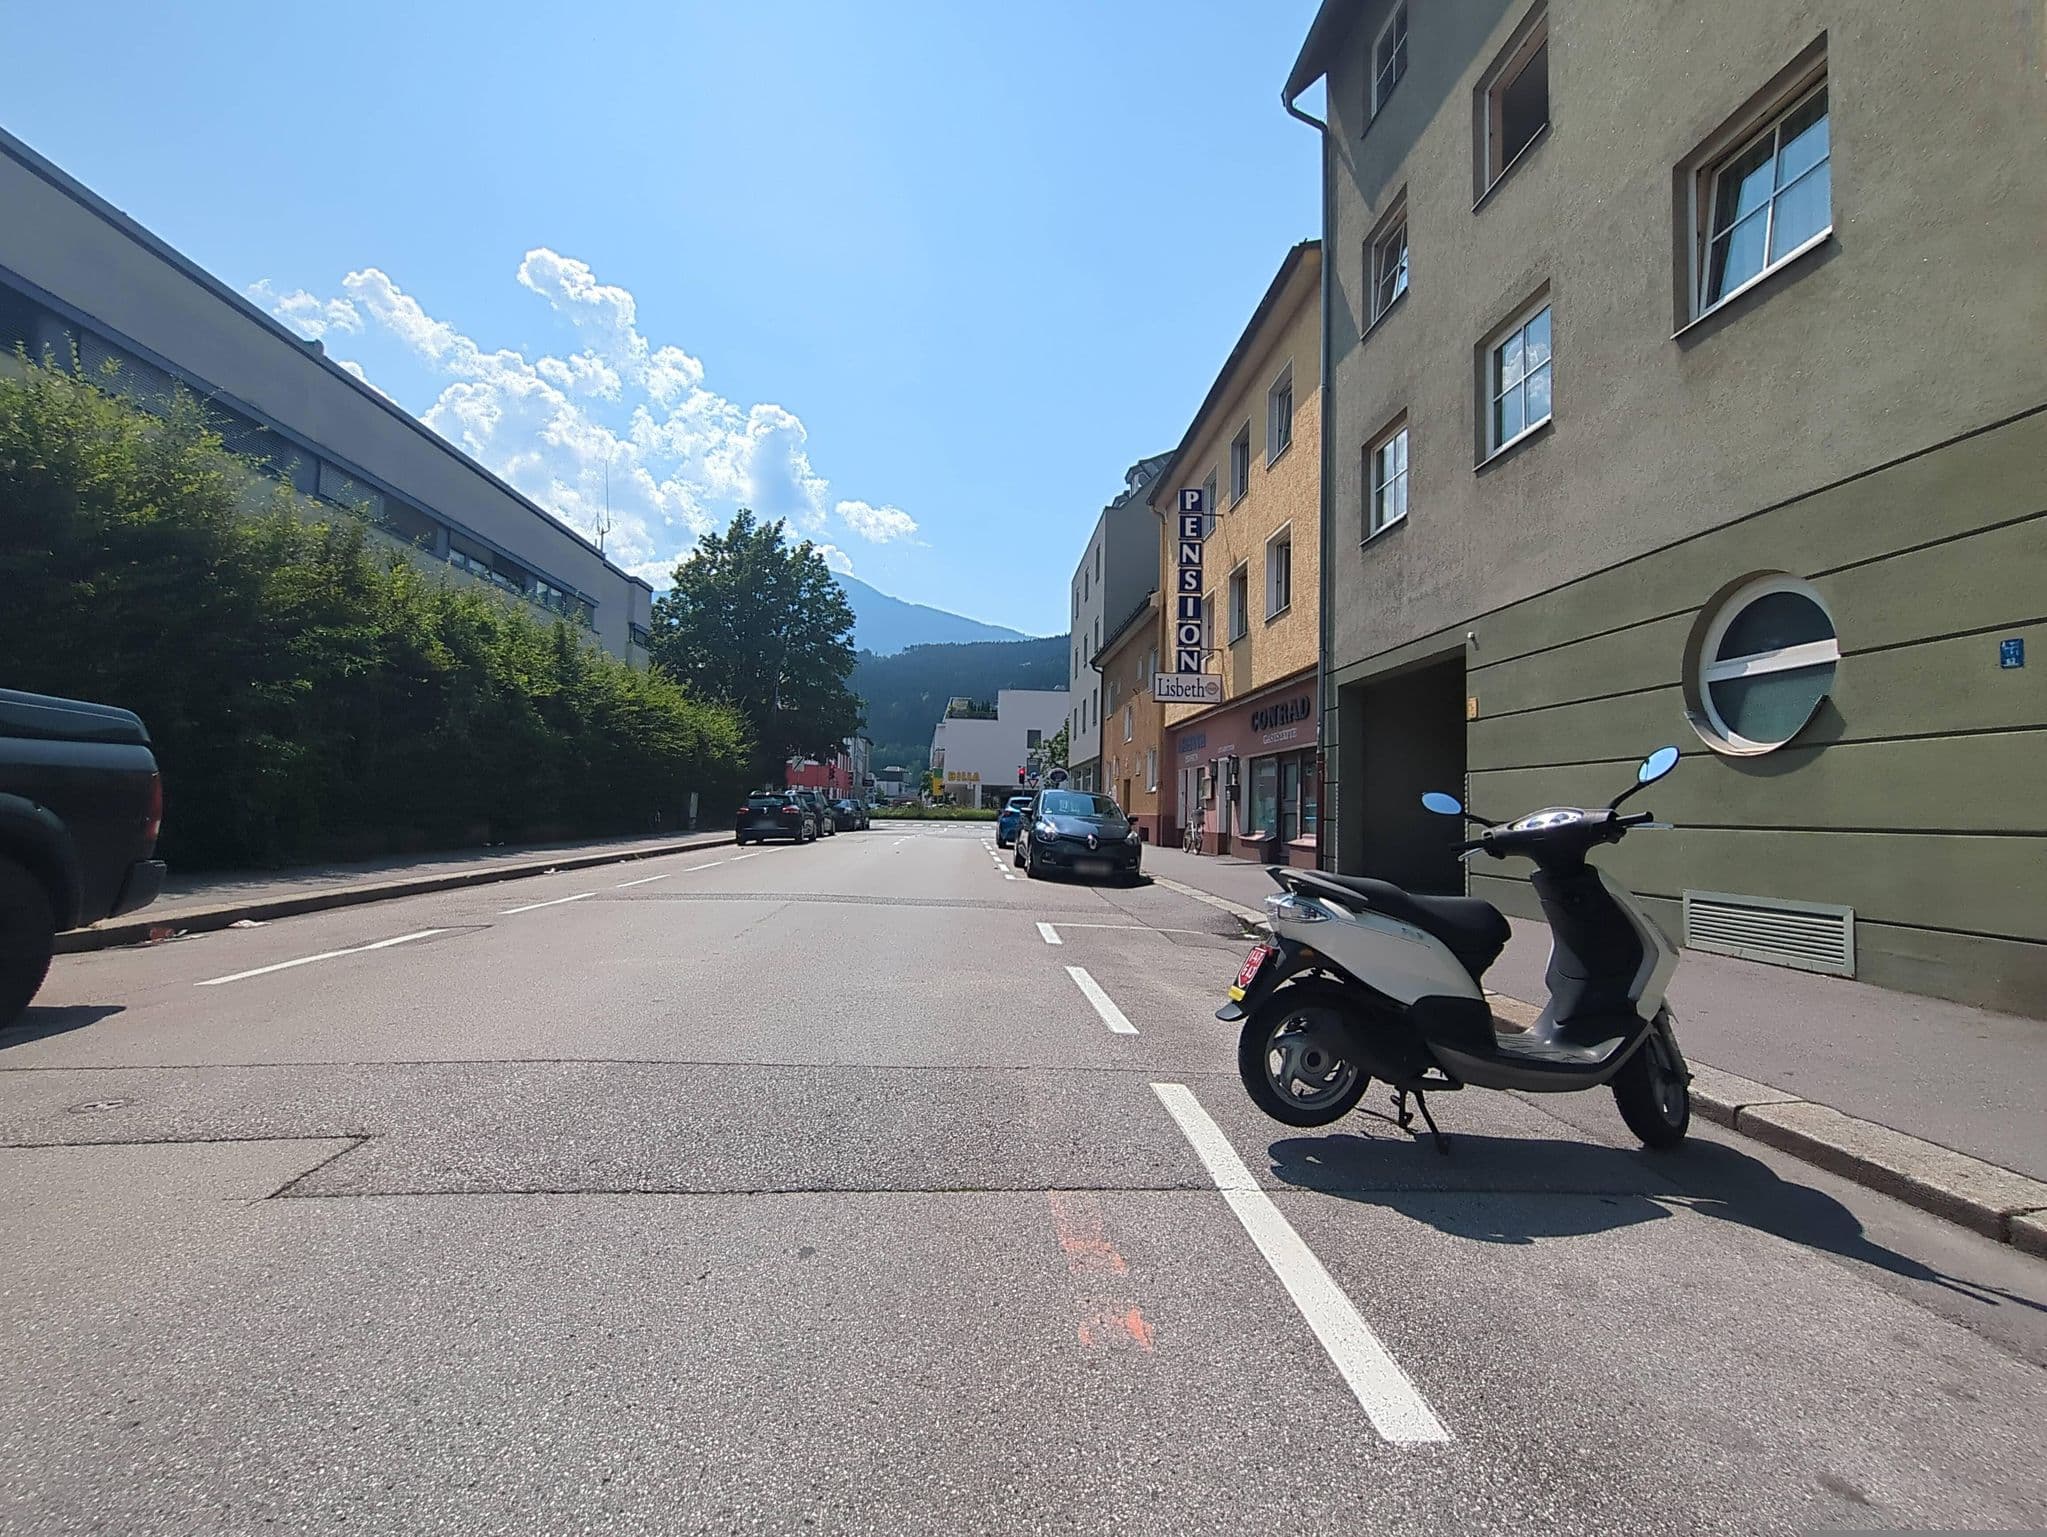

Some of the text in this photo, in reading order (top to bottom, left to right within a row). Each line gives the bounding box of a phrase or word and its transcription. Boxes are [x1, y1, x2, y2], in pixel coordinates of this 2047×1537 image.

[1179, 490, 1201, 672] PENSION
[1157, 677, 1206, 699] Lisbeth
[1251, 696, 1311, 732] CONRAD
